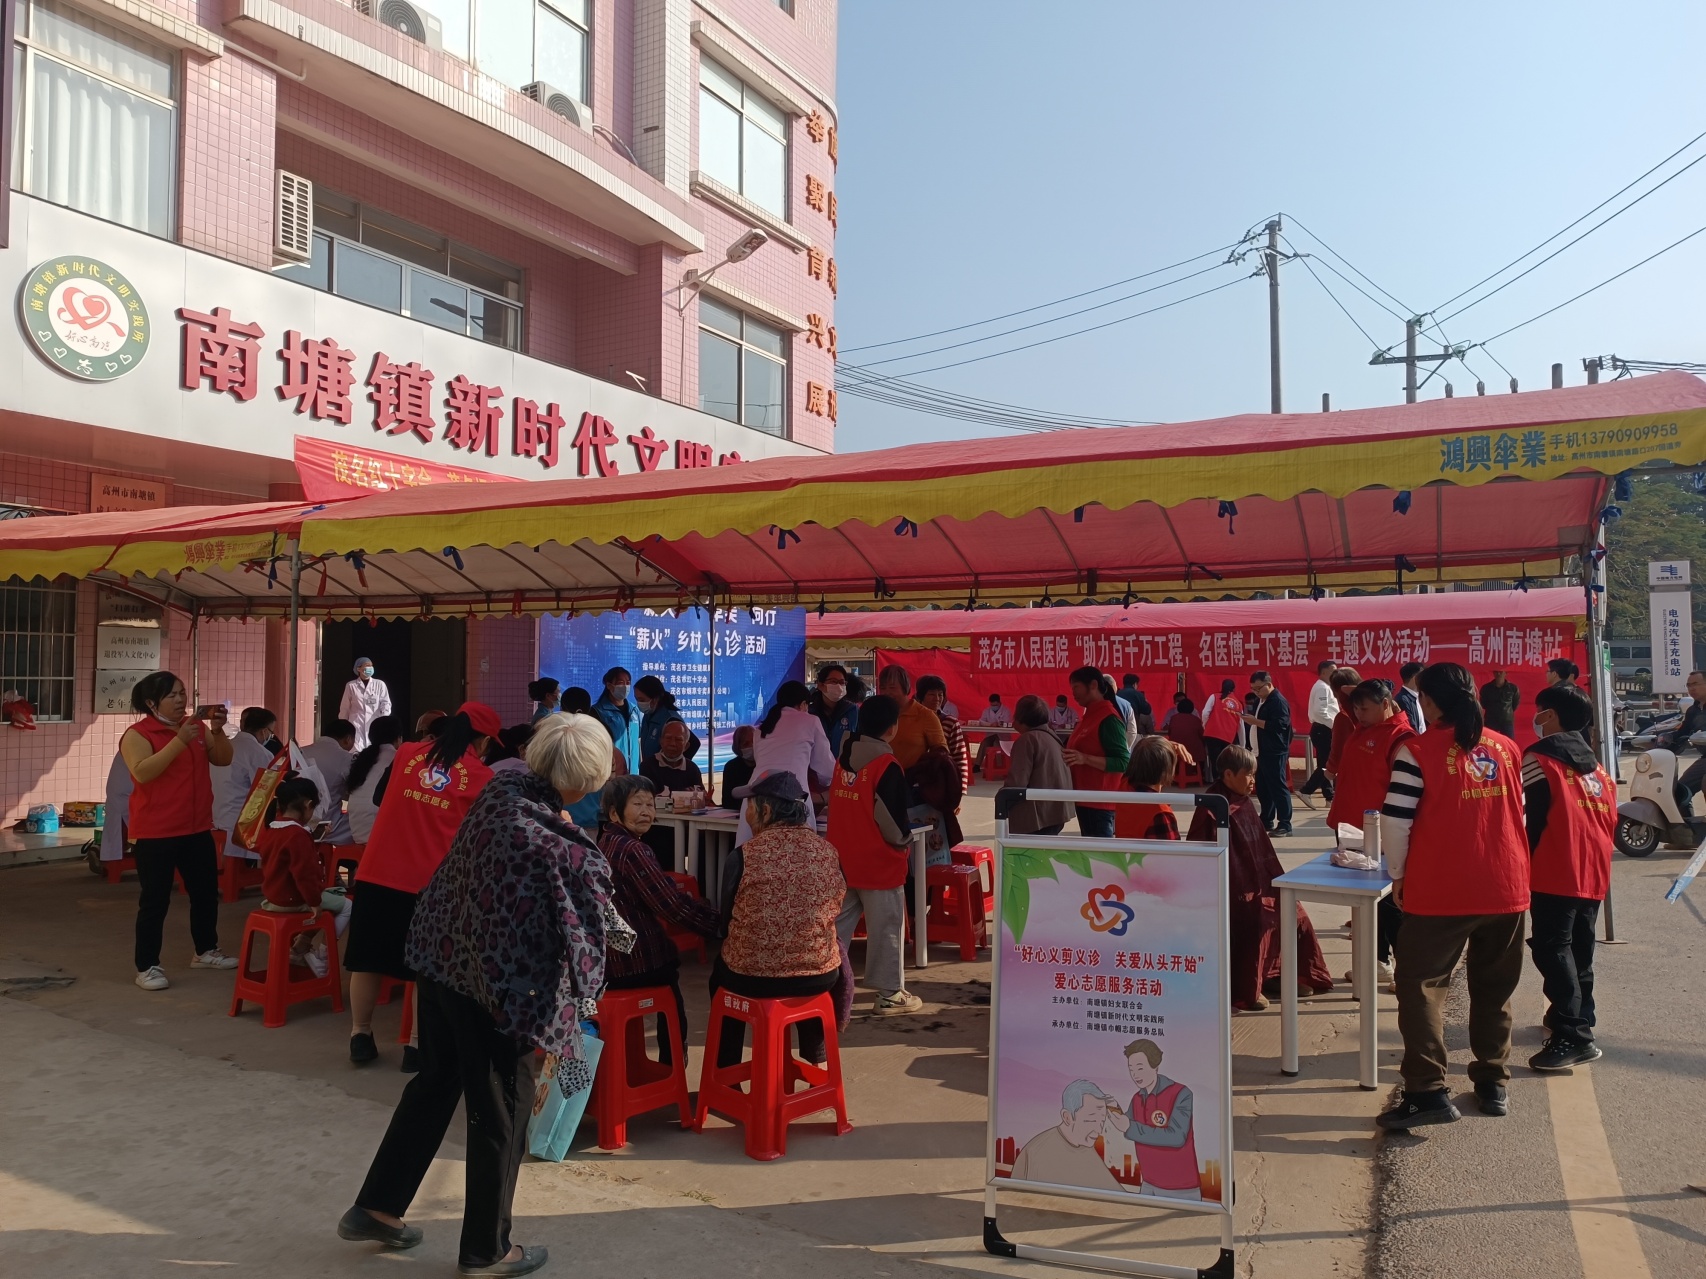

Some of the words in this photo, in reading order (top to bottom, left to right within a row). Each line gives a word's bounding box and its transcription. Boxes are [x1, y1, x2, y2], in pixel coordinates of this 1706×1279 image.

[30, 261, 145, 344] 南塘镇新时代文明实践所
[1550, 422, 1679, 449] 手机13790909958
[102, 484, 156, 502] 高州市南塘镇
[1668, 608, 1681, 677] 电动汽车充电站
[403, 788, 451, 810] 巾帼志愿者
[1461, 784, 1508, 800] 巾帼志愿者
[1054, 972, 1163, 997] 爱心志愿服务活动
[1086, 1010, 1165, 1024] 南塘镇新时代文明实践所
